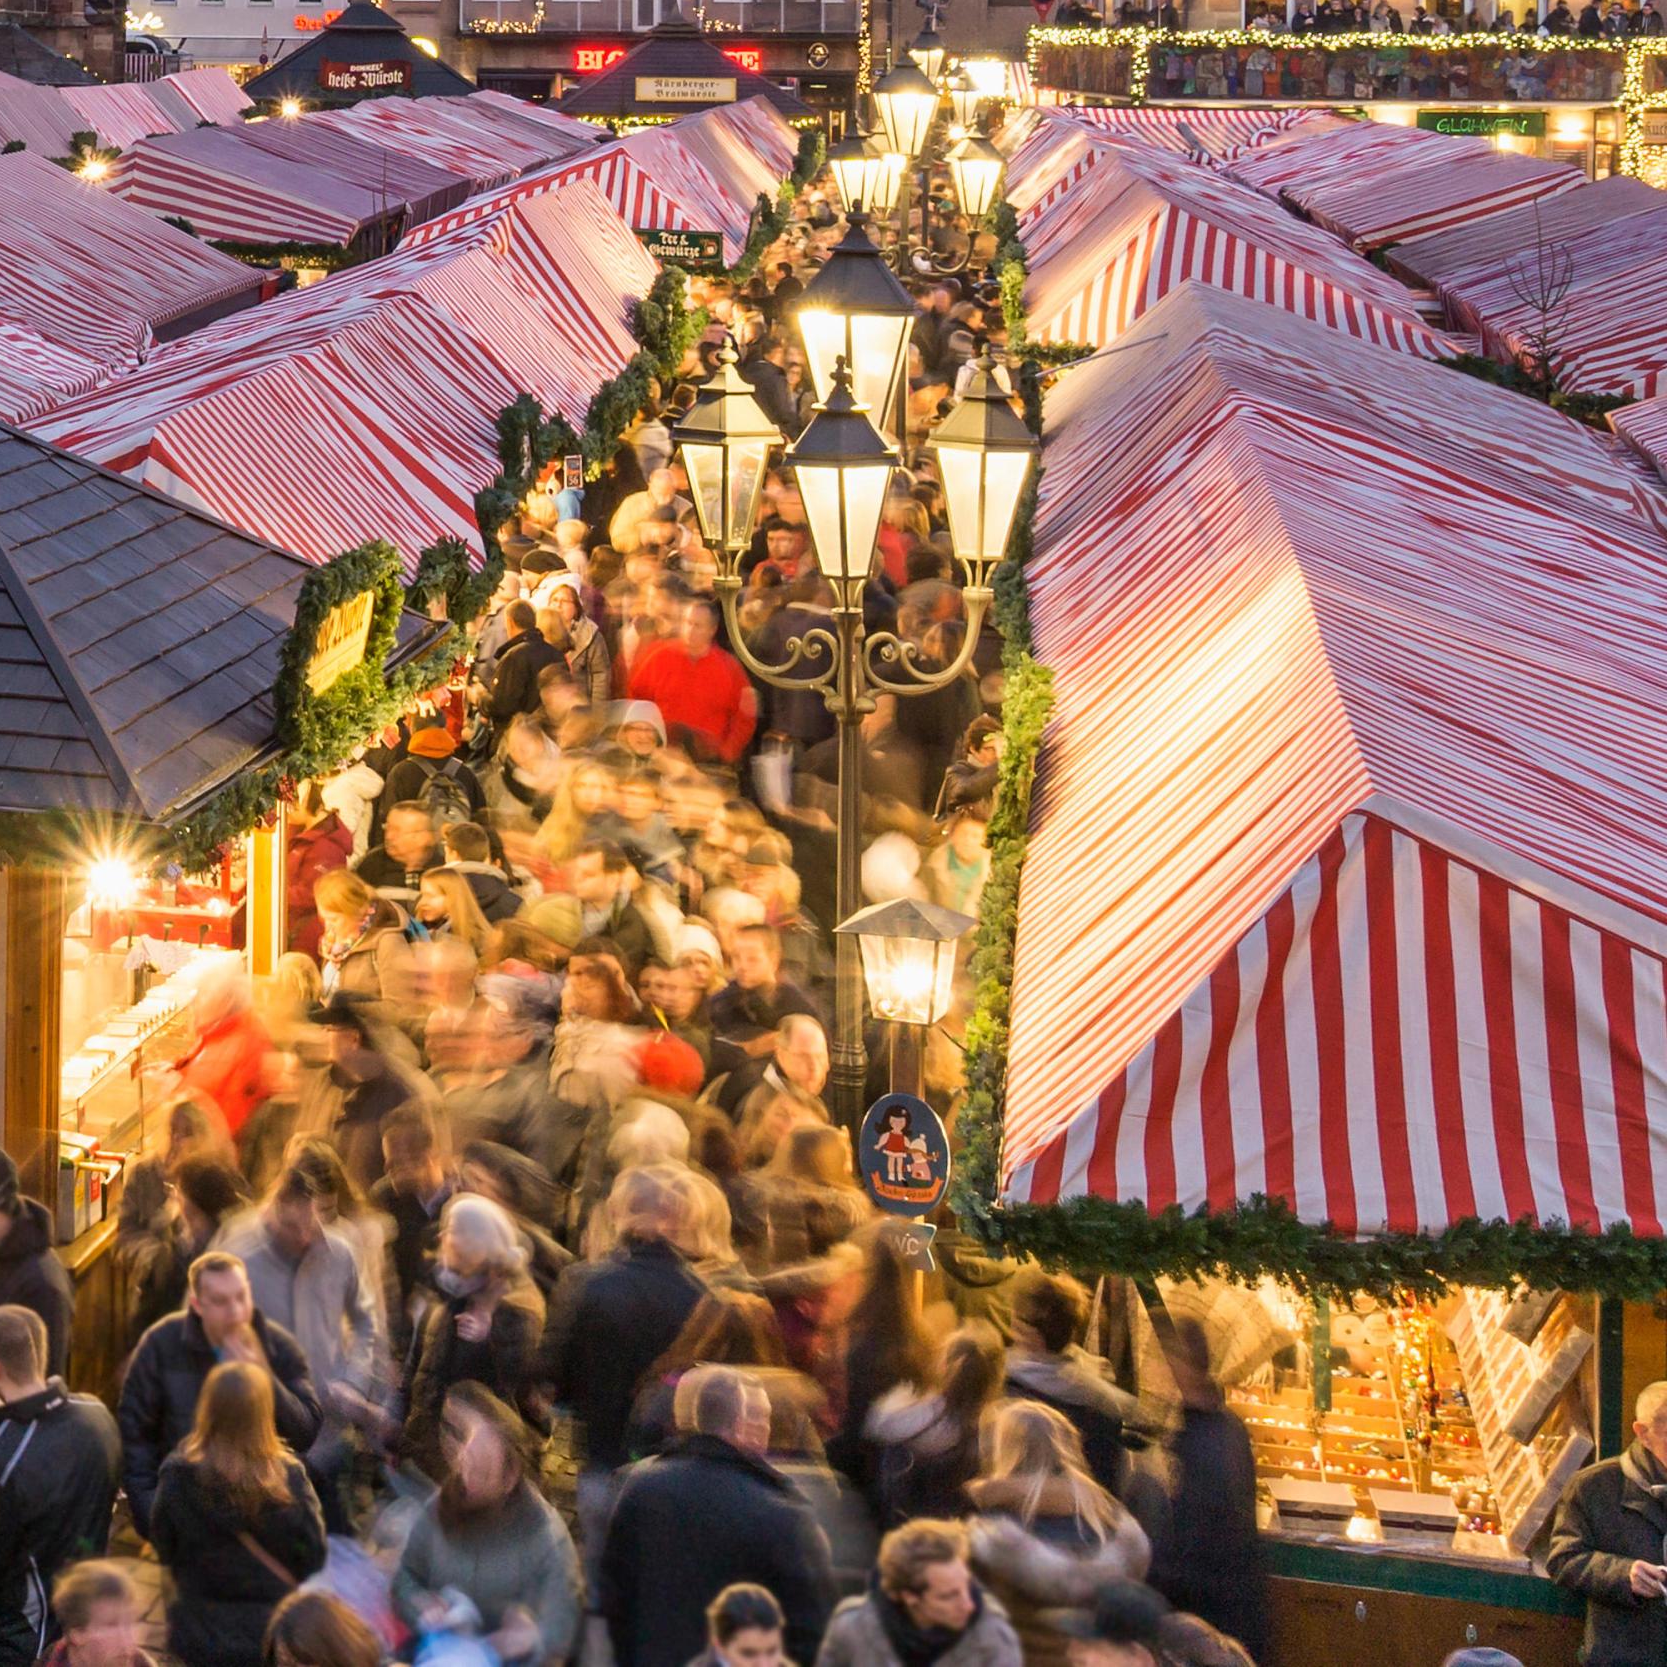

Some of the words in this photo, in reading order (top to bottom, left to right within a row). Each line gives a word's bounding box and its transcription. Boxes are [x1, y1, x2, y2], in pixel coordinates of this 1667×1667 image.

[359, 68, 404, 87] Würste
[658, 231, 678, 245] Tee
[890, 1237, 920, 1255] WC
